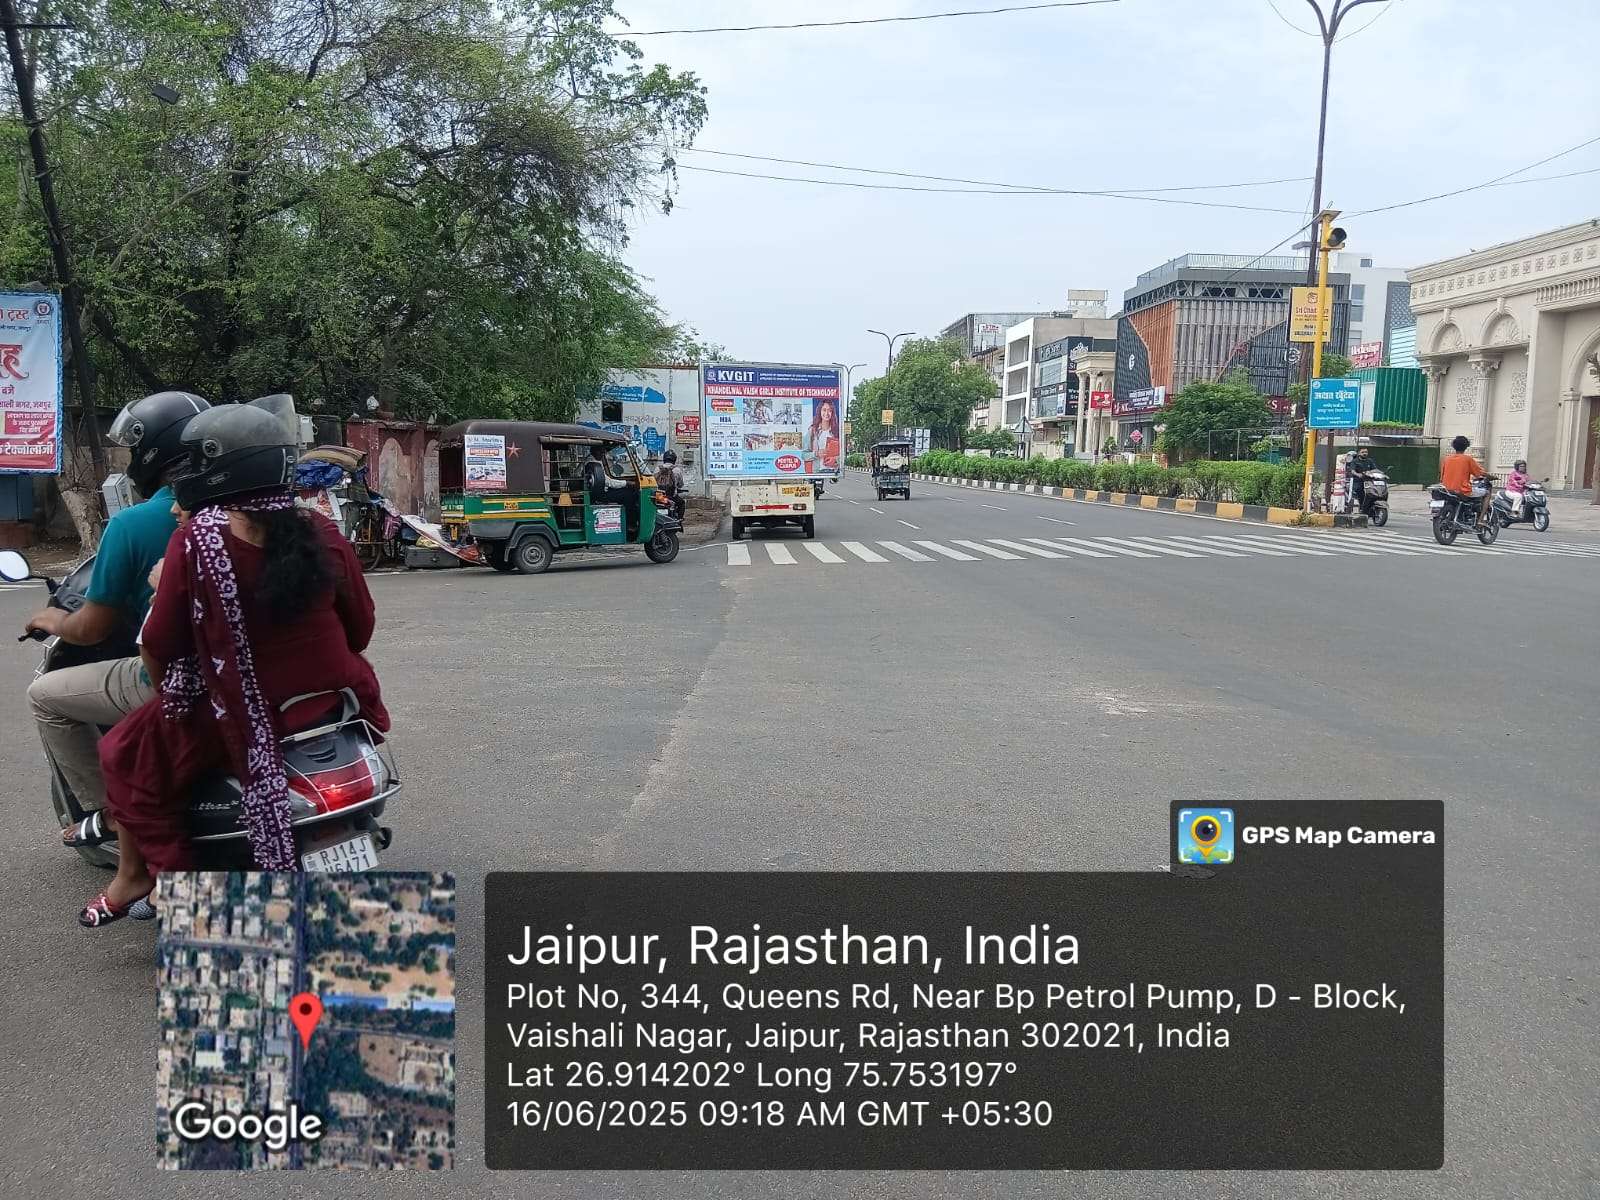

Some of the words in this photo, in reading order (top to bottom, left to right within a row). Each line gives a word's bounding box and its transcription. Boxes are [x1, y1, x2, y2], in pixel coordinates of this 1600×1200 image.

[718, 370, 755, 382] KVGIT
[707, 385, 742, 395] KHANDELWAL
[759, 387, 774, 396] GIRLS
[775, 387, 798, 396] INSTITUTE
[799, 388, 806, 396] OF
[806, 388, 838, 397] TECHNOLOGY
